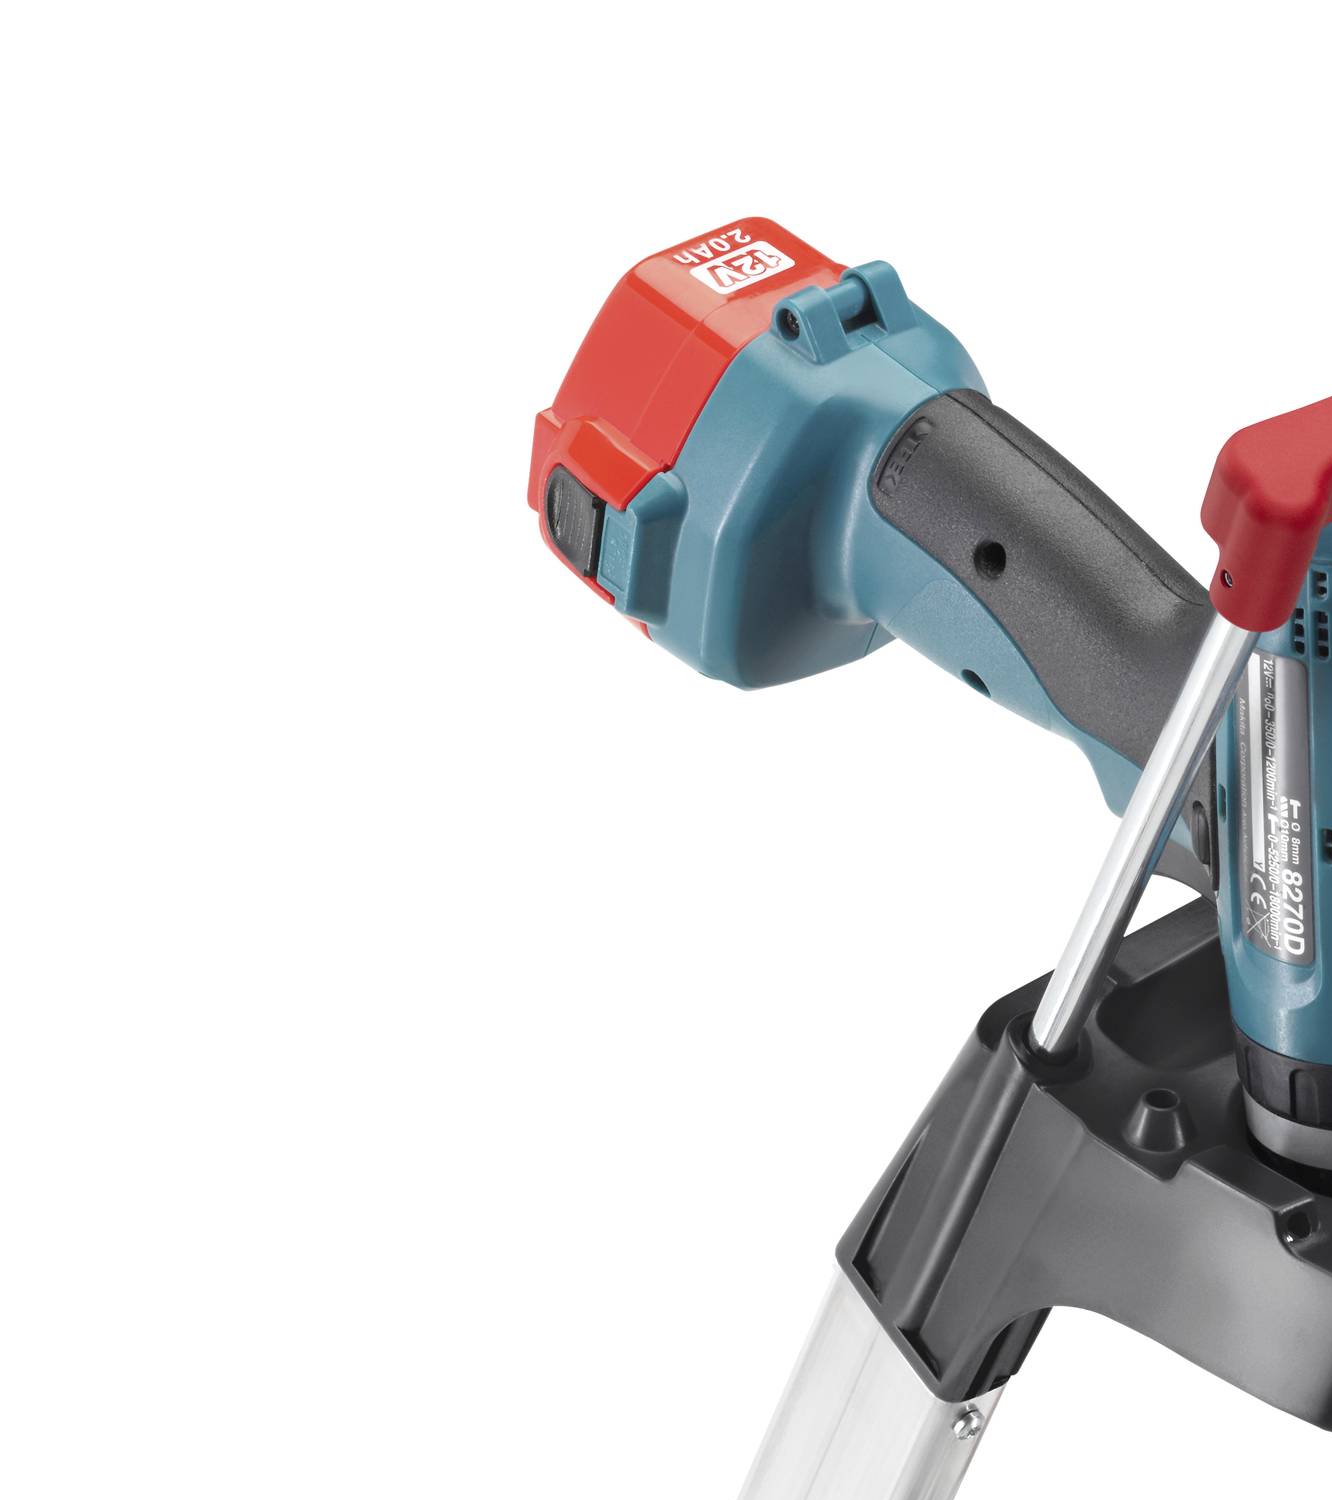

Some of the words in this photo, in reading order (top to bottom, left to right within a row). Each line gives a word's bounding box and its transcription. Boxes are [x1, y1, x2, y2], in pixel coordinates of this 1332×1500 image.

[673, 229, 751, 264] 2.0Ah
[707, 249, 781, 287] 12V
[1282, 868, 1305, 956] 8270D
